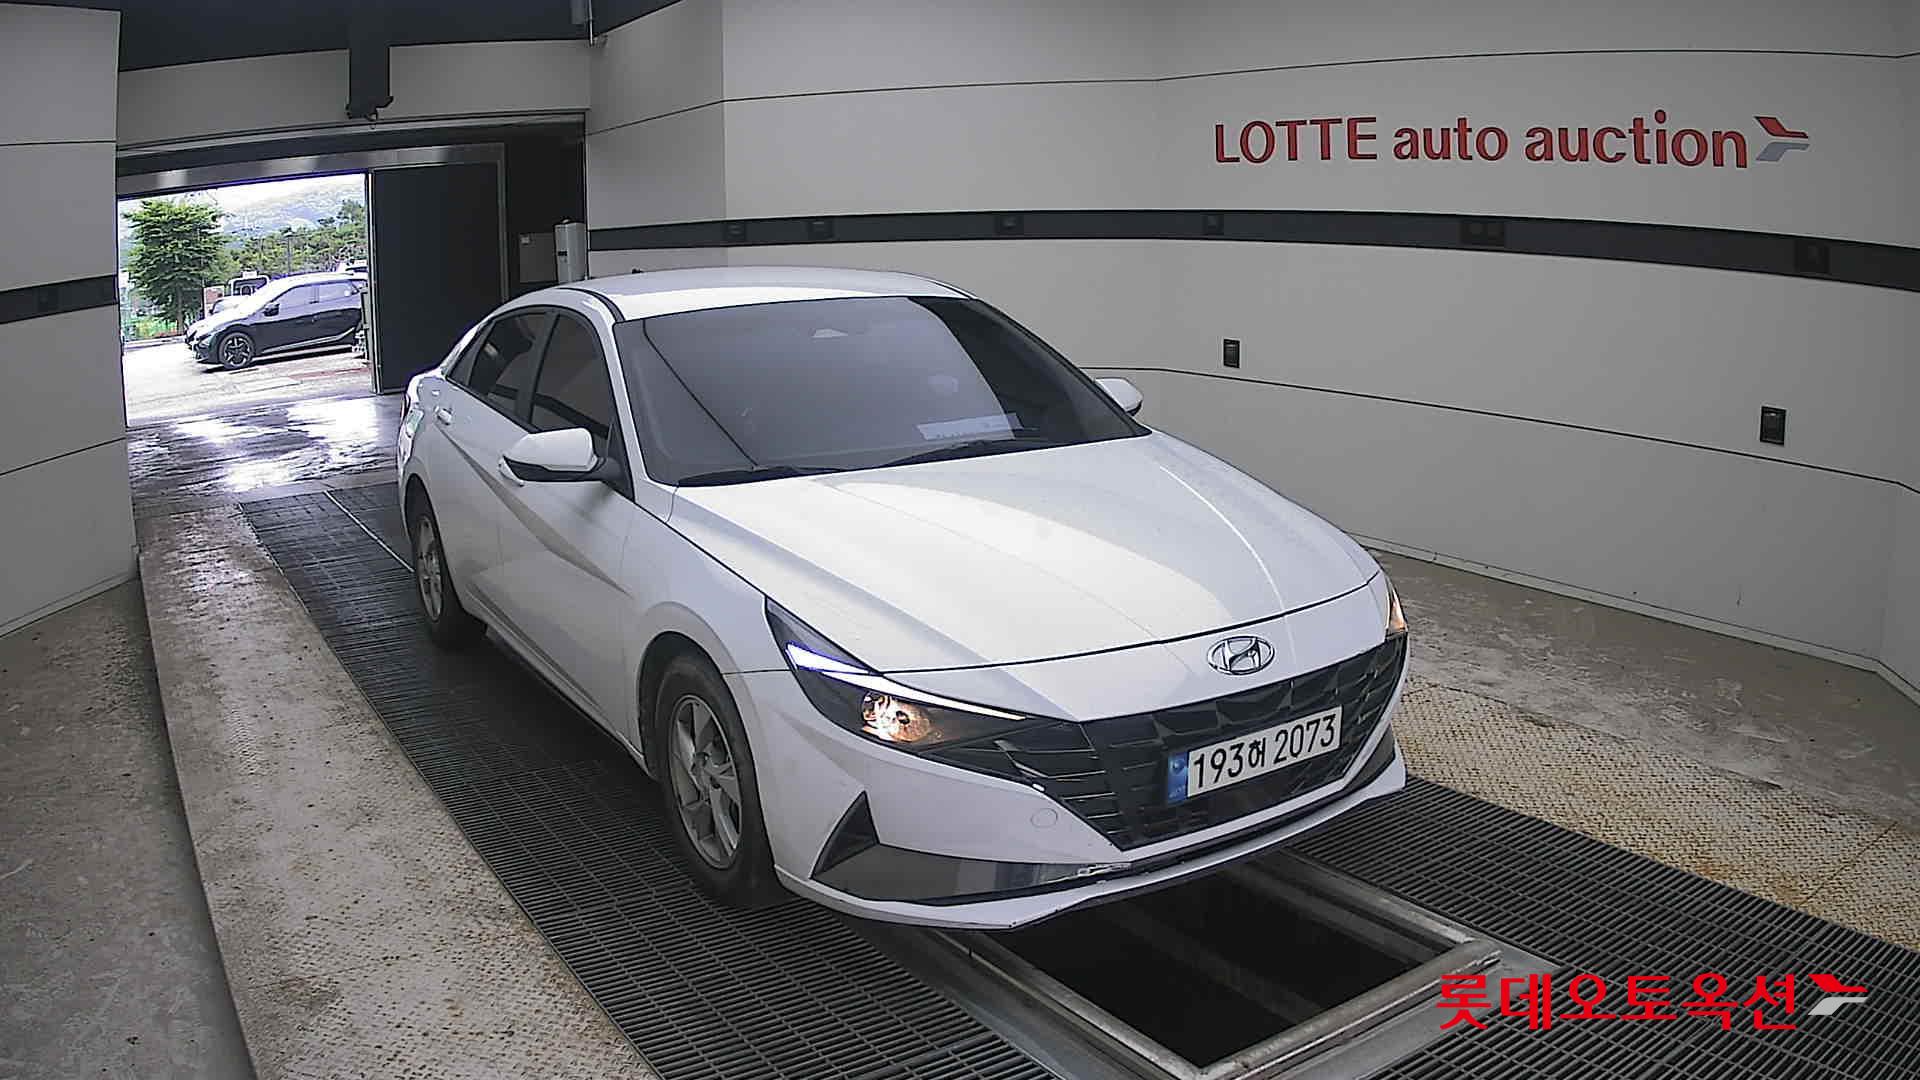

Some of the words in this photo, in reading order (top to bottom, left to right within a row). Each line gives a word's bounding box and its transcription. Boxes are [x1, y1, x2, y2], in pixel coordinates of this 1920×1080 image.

[1215, 116, 1377, 164] LOTTE
[1393, 117, 1508, 162] auto
[1524, 109, 1748, 169] auction
[1273, 713, 1337, 765] 2073
